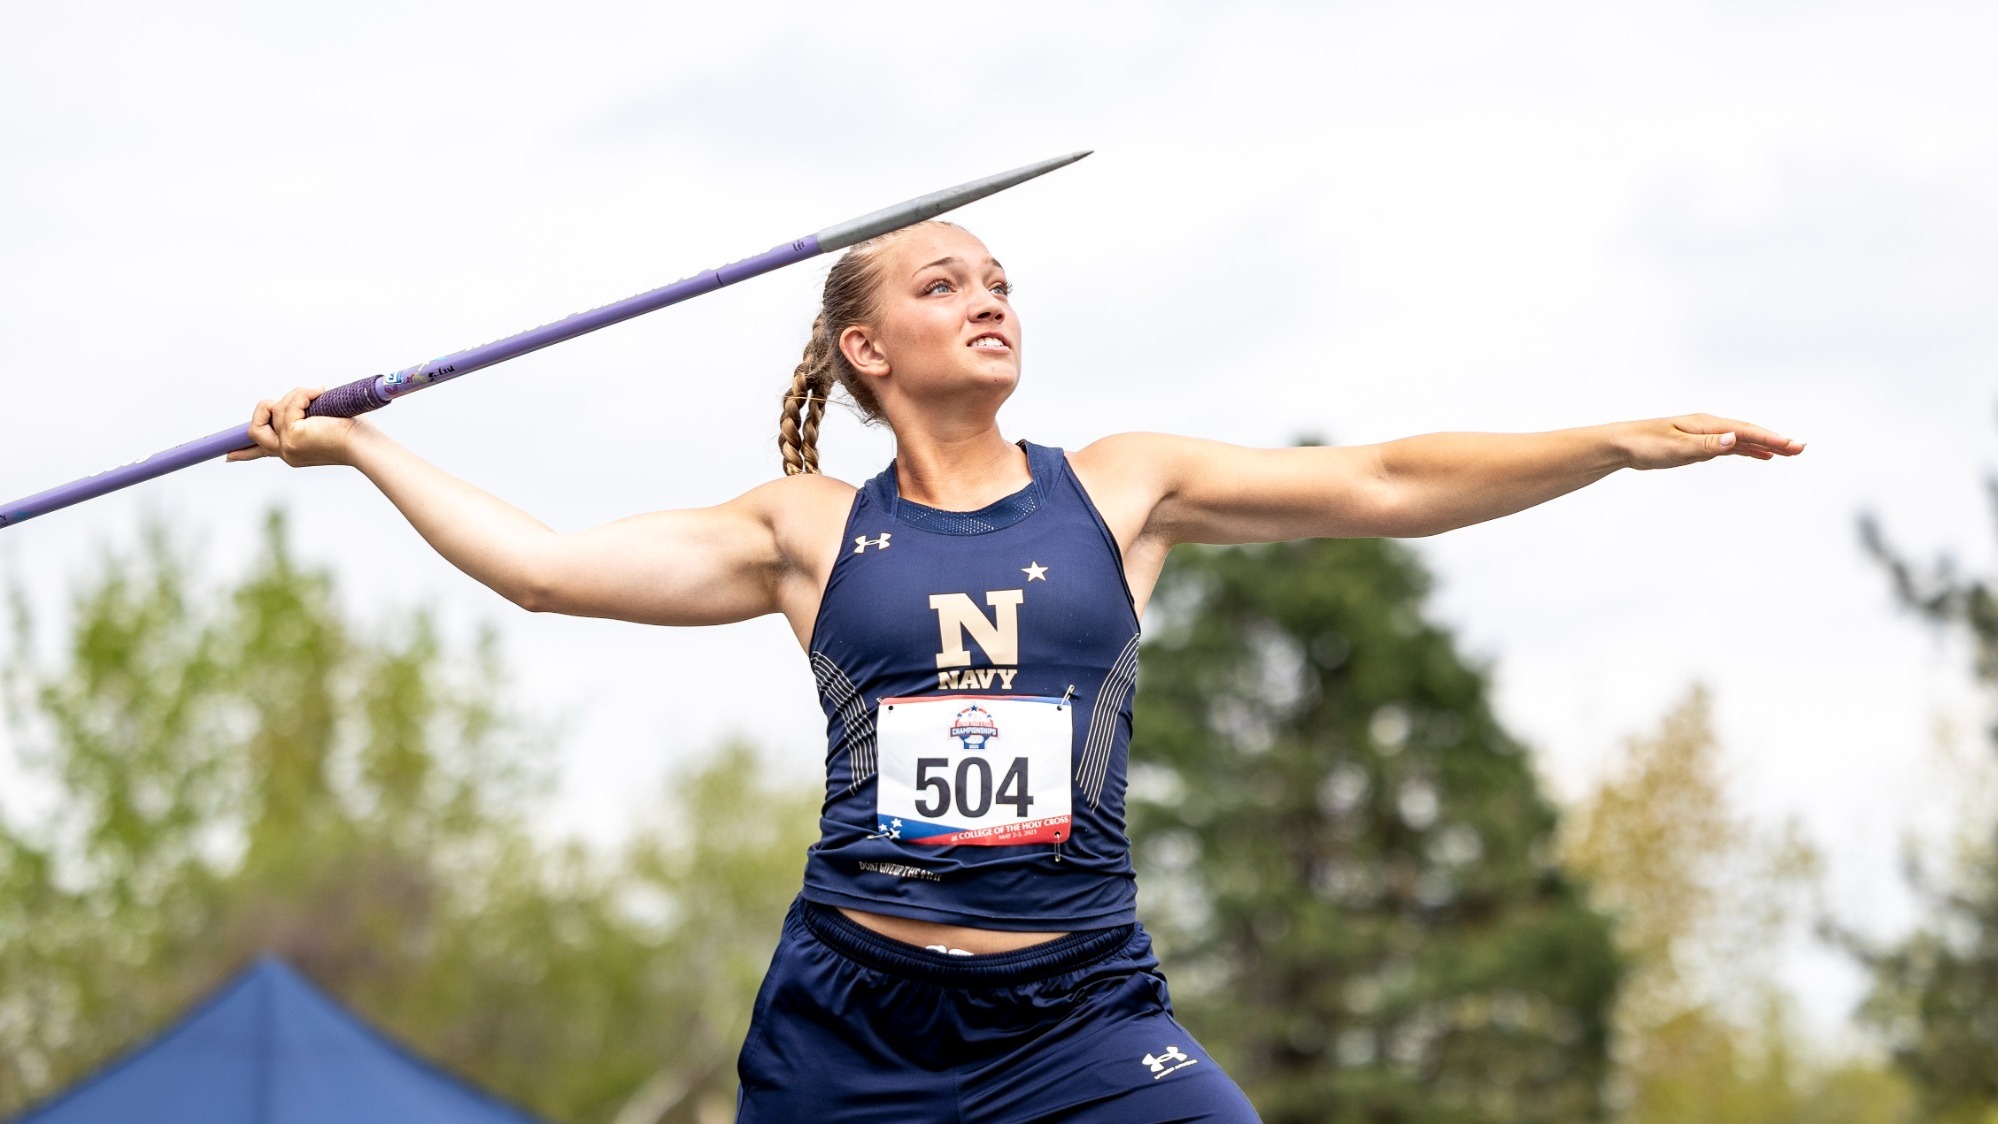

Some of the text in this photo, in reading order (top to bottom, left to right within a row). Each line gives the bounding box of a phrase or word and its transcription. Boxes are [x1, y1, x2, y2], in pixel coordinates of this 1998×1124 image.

[929, 589, 1024, 669] N
[938, 669, 1018, 690] NAVY
[915, 757, 1034, 818] 504
[959, 829, 993, 840] COLLEGE
[994, 826, 1005, 834] OF
[1006, 823, 1021, 832] THE
[1022, 820, 1042, 830] HOLY
[1044, 816, 1069, 826] CROSS
[902, 866, 920, 878] THE
